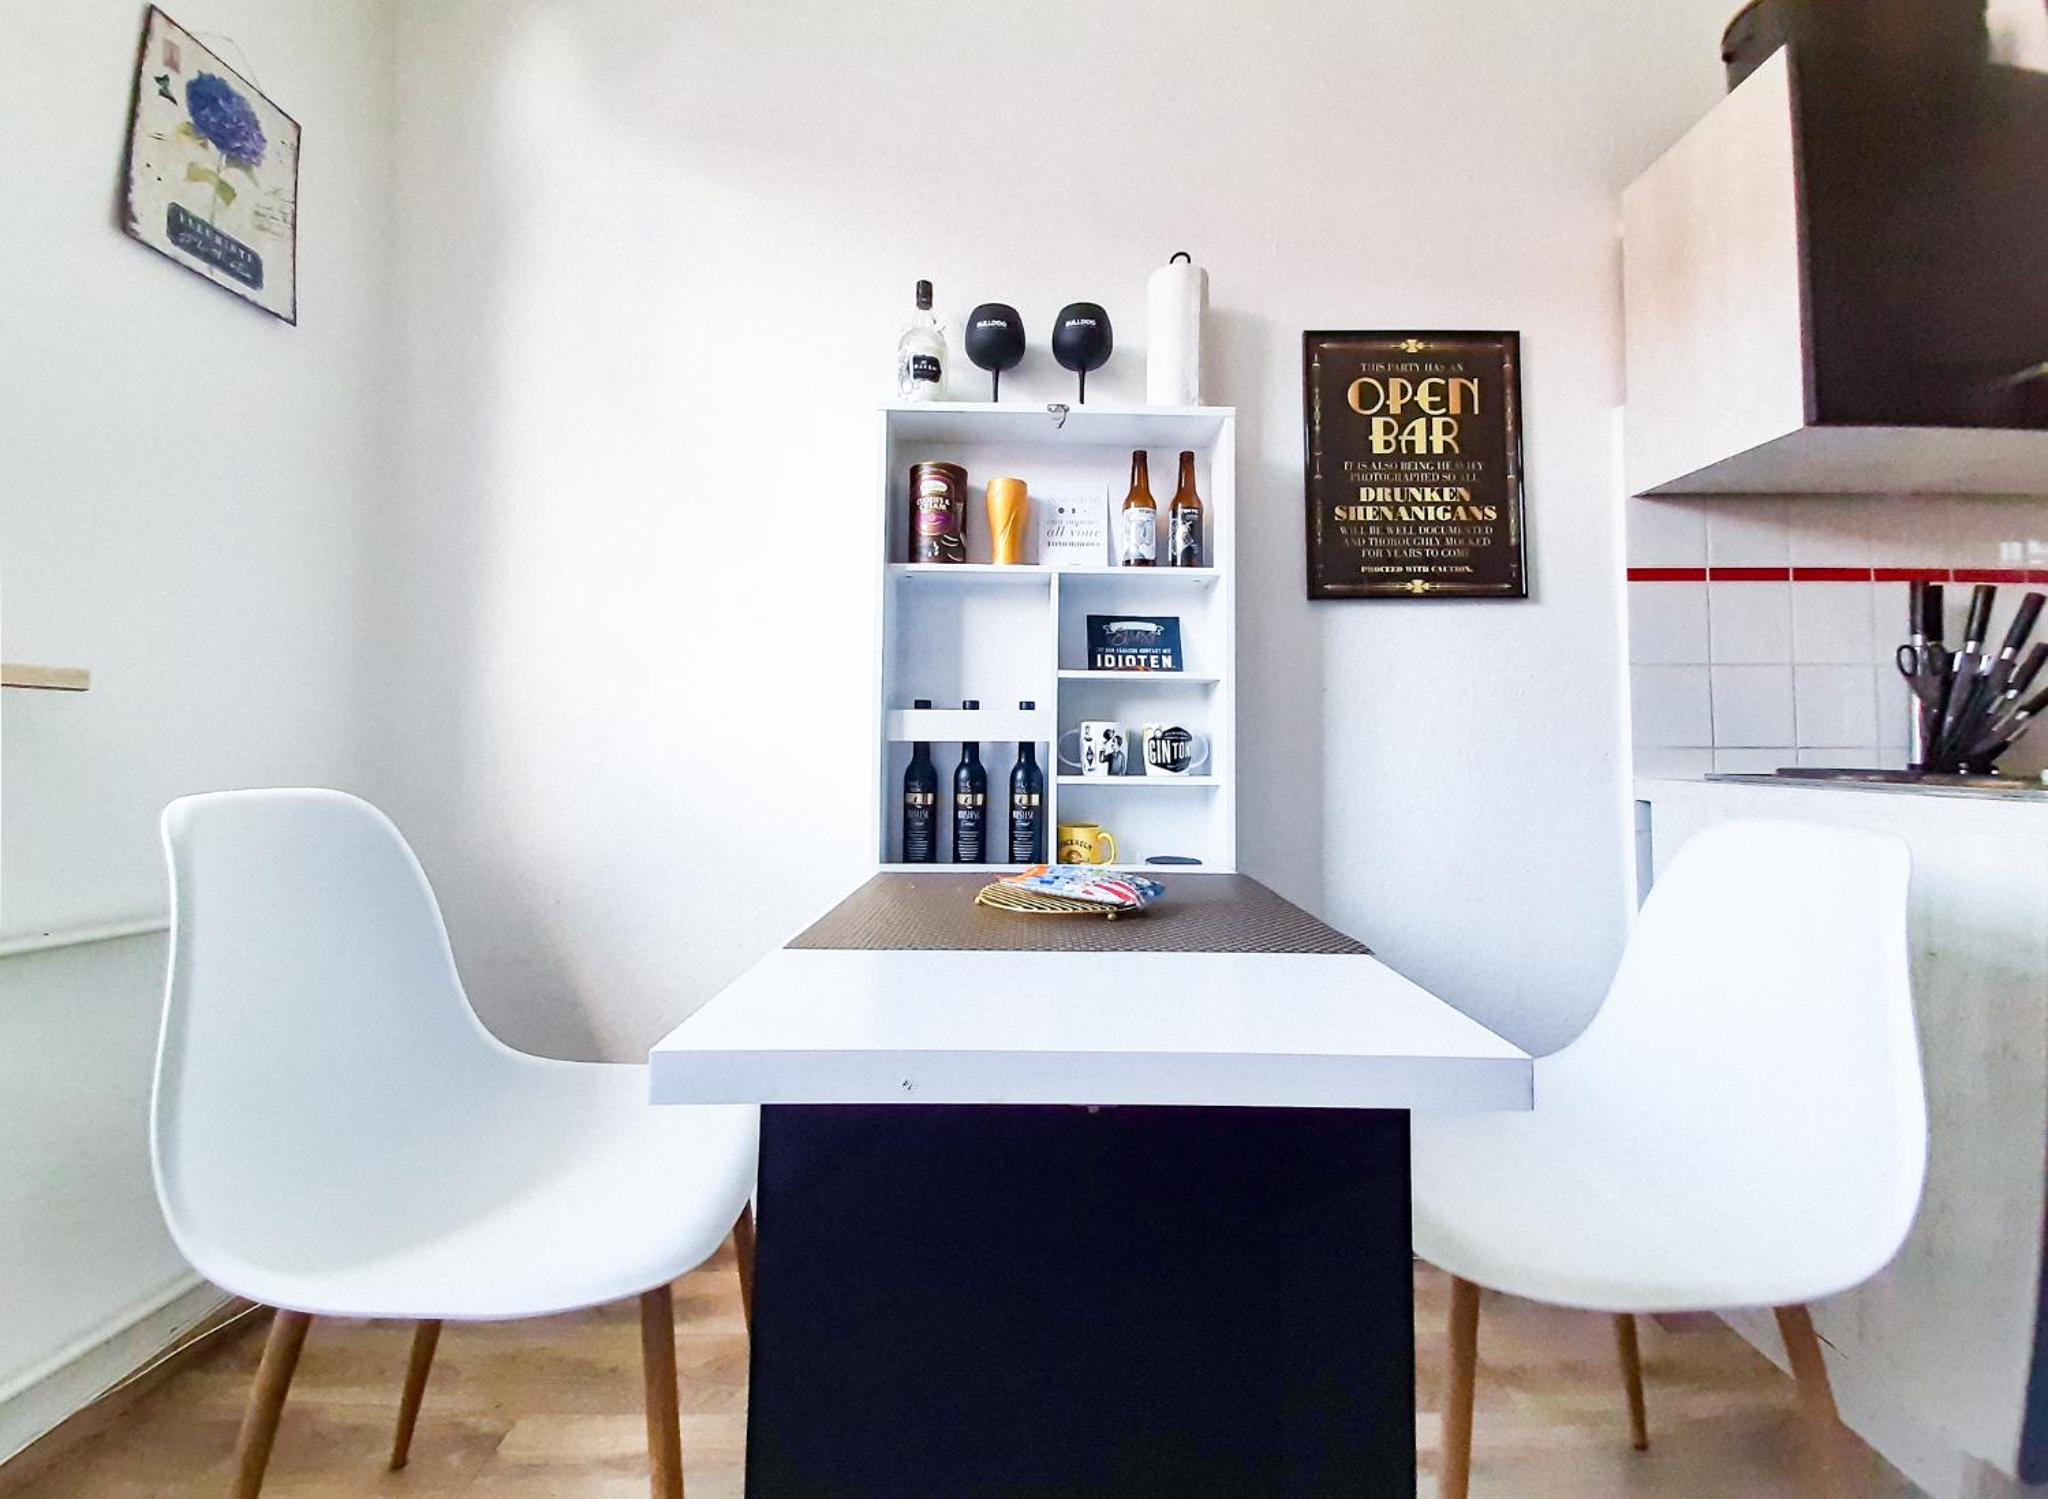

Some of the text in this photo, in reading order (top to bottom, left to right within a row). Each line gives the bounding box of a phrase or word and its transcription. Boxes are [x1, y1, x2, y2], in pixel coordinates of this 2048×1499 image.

[976, 319, 1007, 328] BULLDOG
[1065, 319, 1097, 328] BULLDOG
[1360, 362, 1385, 372] THIS
[1387, 362, 1420, 372] PARTY
[1347, 376, 1480, 415] OPEN
[1368, 416, 1460, 455] BAR
[1356, 460, 1367, 471] IS
[1370, 460, 1398, 471] ALSO
[1400, 460, 1435, 471] BEING
[1350, 472, 1440, 482] PHOTOGRAPHED
[1441, 472, 1456, 482] SO
[1359, 486, 1472, 502] DRUNKEN
[1334, 505, 1498, 521] SHENANIGANS
[1339, 525, 1494, 536] WILL BE WELL DOCUMENTED
[1343, 537, 1366, 546] AND
[1367, 537, 1441, 546] THOROUGHLY
[1361, 548, 1383, 558] FOR
[1385, 548, 1423, 558] YEARS
[1425, 548, 1438, 558] TO
[1360, 565, 1403, 573] PROCEED
[1405, 565, 1429, 573] WITH
[1148, 739, 1172, 764] GIN
